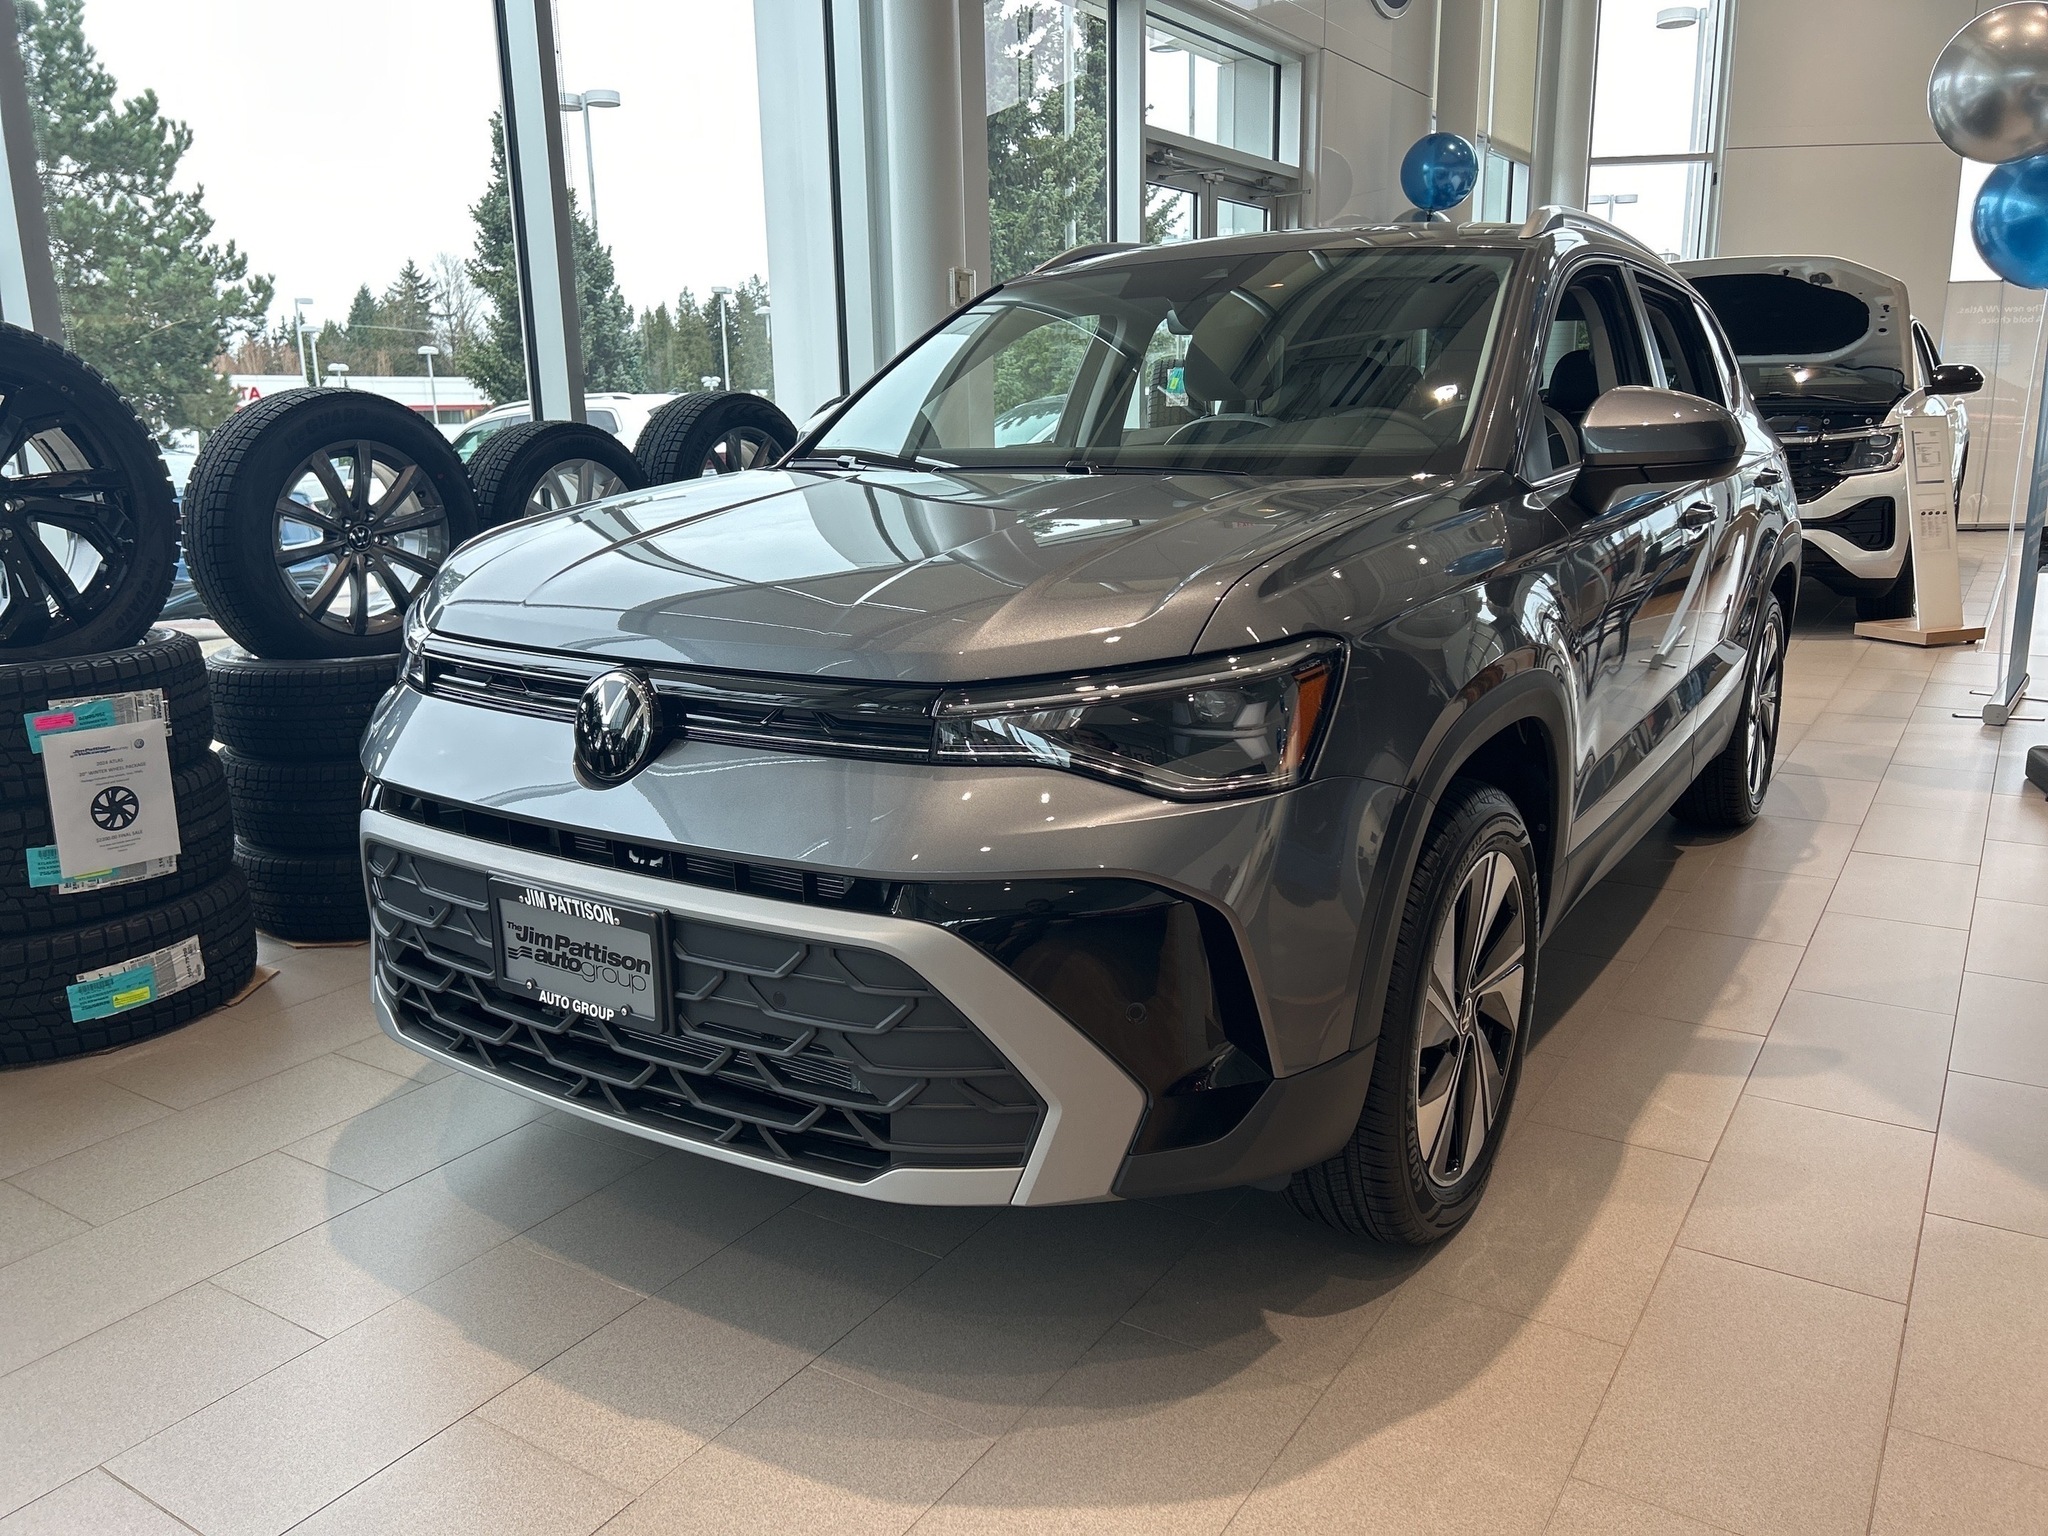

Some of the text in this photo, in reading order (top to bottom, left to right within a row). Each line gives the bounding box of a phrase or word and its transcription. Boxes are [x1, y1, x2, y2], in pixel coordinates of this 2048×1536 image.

[524, 888, 614, 925] JIM PATTISON
[507, 921, 523, 932] The
[538, 990, 615, 1021] AUTO GROUP
